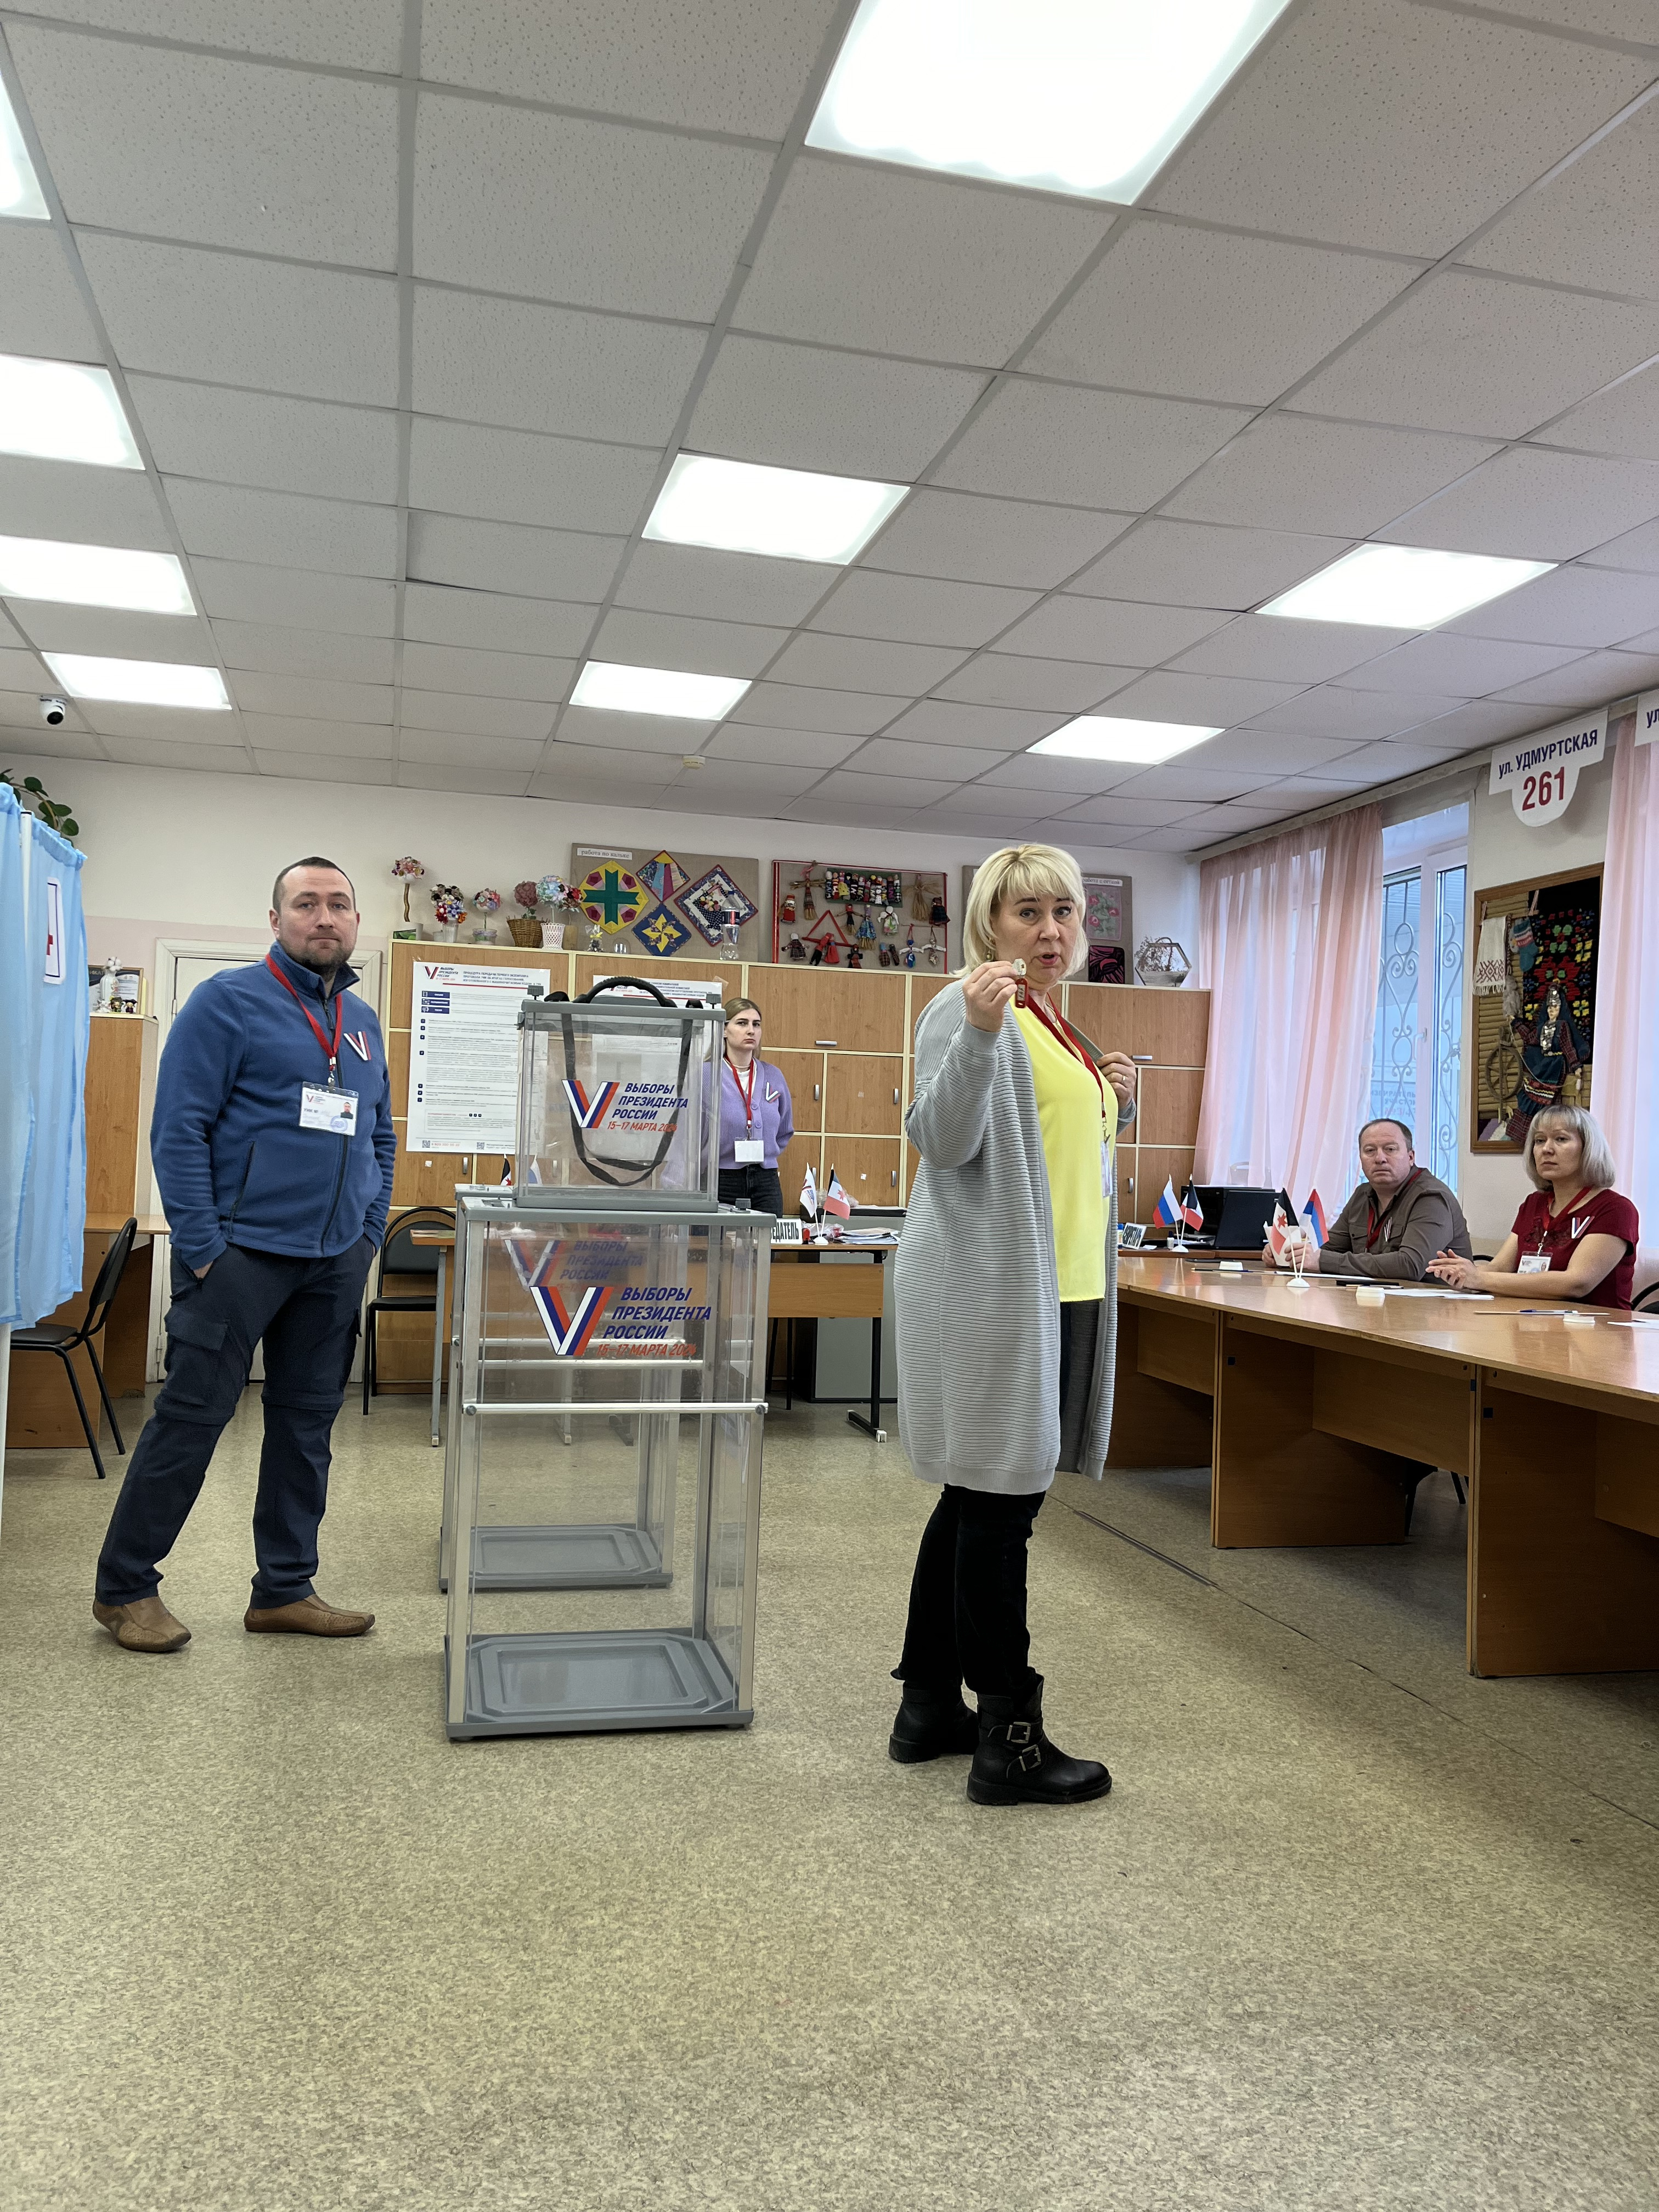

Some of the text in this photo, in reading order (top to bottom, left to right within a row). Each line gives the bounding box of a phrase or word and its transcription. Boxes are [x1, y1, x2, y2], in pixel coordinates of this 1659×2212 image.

[1499, 729, 1598, 780] ул. УДМУРТСКАЯ
[1522, 766, 1565, 811] 261
[625, 1083, 675, 1094] ВЫБОРЫ
[618, 1096, 689, 1108] ПРЕЗИДЕНТА
[612, 1109, 658, 1120] РОССИИ
[630, 1122, 657, 1131] МАРТА
[658, 1123, 678, 1132] 202
[574, 1241, 628, 1251] ВЫБОРЫ
[567, 1255, 644, 1266] ПРЕЗИДЕНТА
[560, 1269, 610, 1280] РОССИИ
[620, 1287, 692, 1301] ВЫБОРЫ
[611, 1306, 712, 1322] ПРЕЗИДЕНТА
[602, 1325, 669, 1339] РОССИИ
[630, 1344, 668, 1356] МАРТА
[668, 1344, 697, 1356] 202
